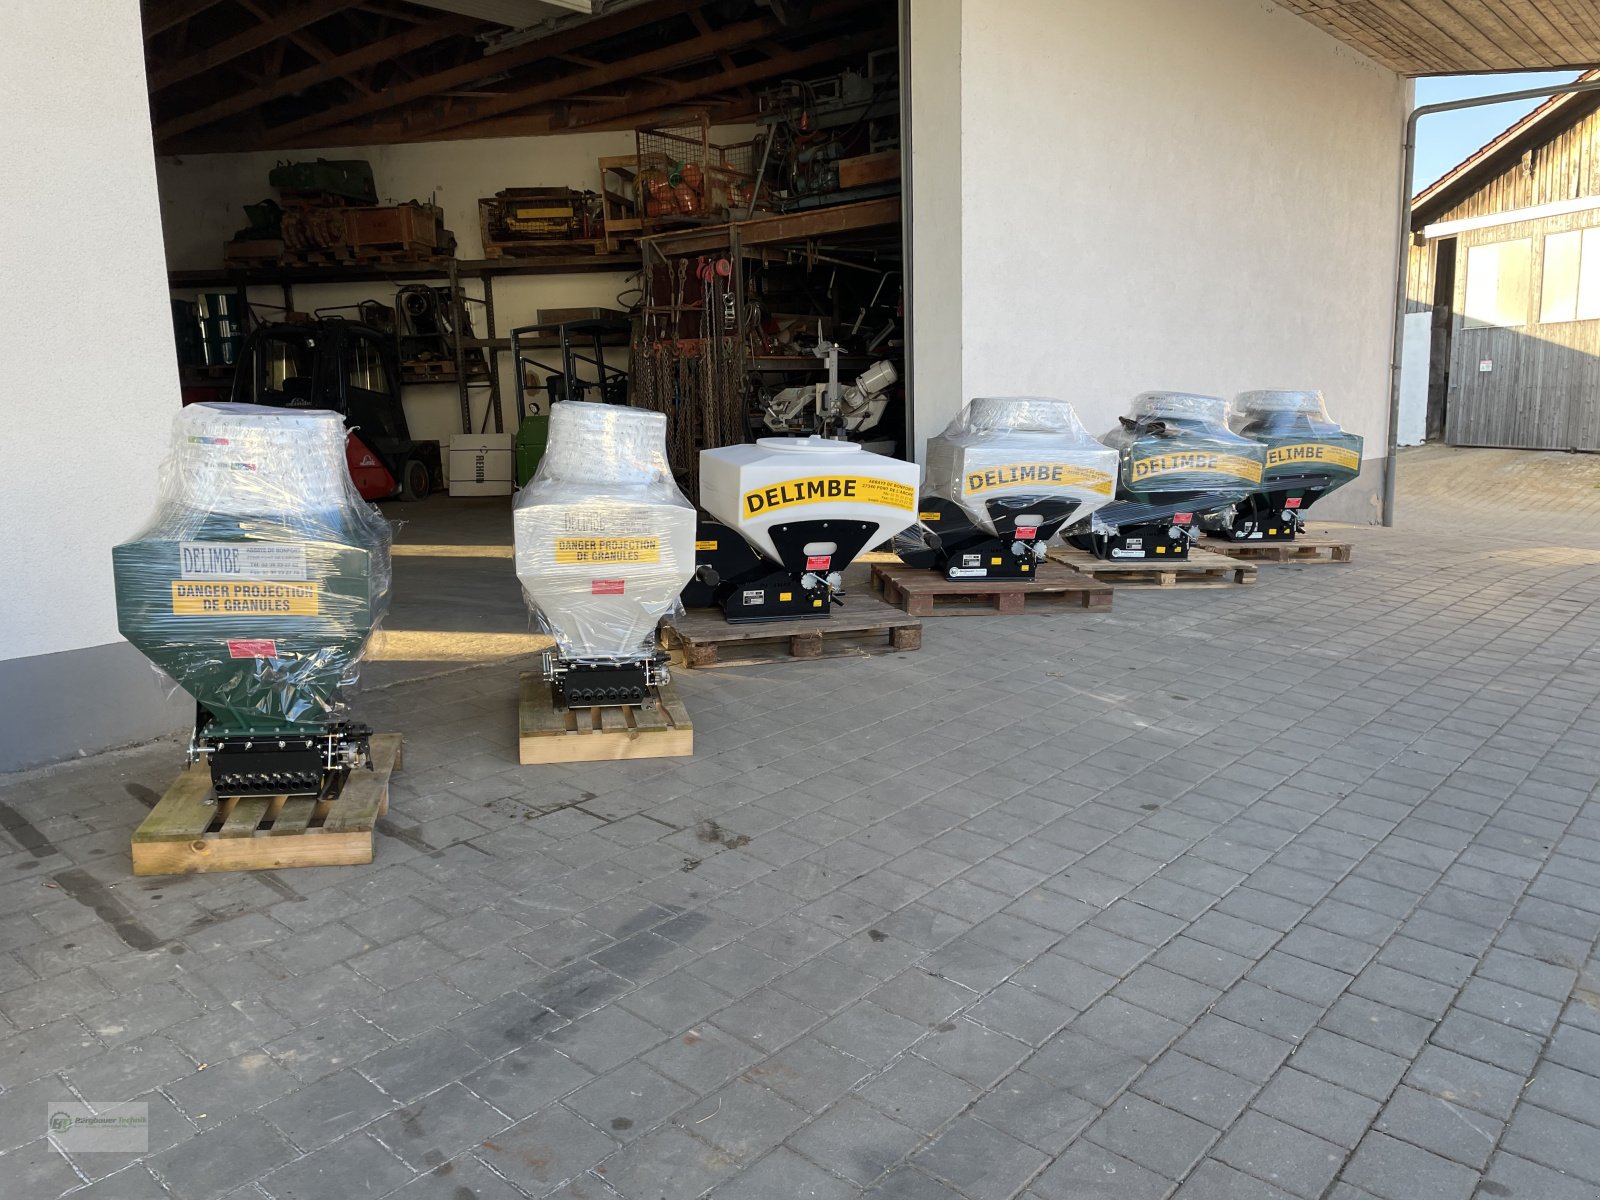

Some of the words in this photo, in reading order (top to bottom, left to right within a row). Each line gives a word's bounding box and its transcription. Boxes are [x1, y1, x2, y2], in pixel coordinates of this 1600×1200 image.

[1268, 447, 1324, 464] ELIMBE
[1136, 455, 1218, 476] DELIMBE
[968, 465, 1064, 490] DELIMBE
[746, 480, 857, 513] DELIMBE
[559, 540, 597, 550] DANGER
[599, 540, 656, 550] PROJECTION
[183, 547, 241, 574] DELIMBE
[576, 551, 589, 561] DE
[591, 551, 639, 561] GRANULES
[177, 584, 230, 597] DANGER
[234, 585, 313, 598] PROJECTION
[203, 599, 220, 611] DE
[224, 599, 290, 612] GRANULES
